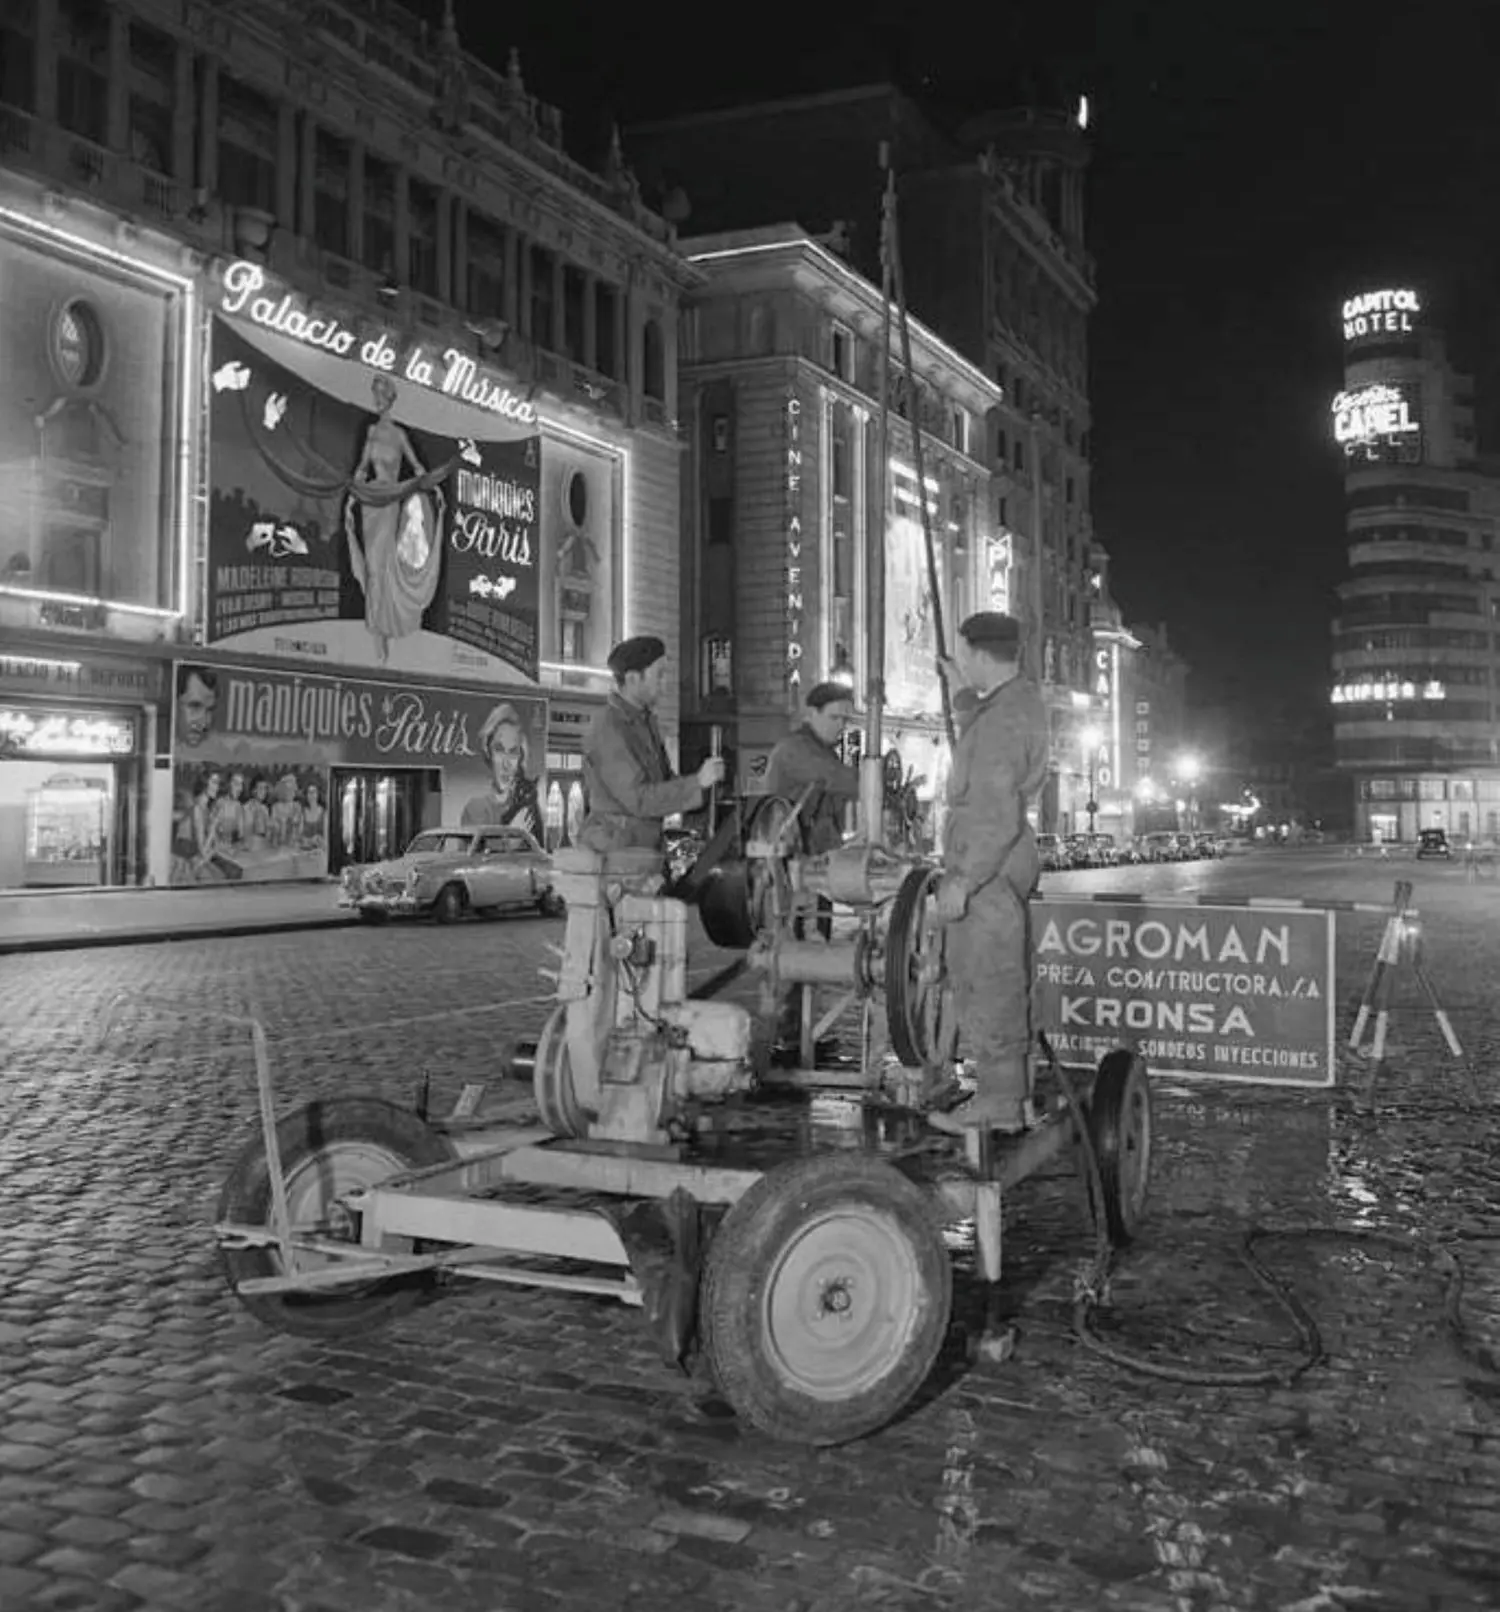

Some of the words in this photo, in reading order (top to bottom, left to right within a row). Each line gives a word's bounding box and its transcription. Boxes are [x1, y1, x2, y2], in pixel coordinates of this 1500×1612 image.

[222, 260, 356, 354] Palacio
[360, 333, 396, 372] de
[405, 347, 433, 386] la
[1342, 289, 1420, 320] CAPITOL
[1343, 311, 1412, 340] HOTEL
[787, 399, 802, 491] CINE
[451, 511, 533, 565] Paris
[788, 516, 803, 685] AVENIDA
[374, 692, 477, 756] Paris
[1036, 917, 1290, 966] AGROMAN
[1060, 995, 1255, 1037] KRONSA
[1137, 1039, 1207, 1060] SONDEOS
[1213, 1043, 1319, 1069] INYECCIONES
